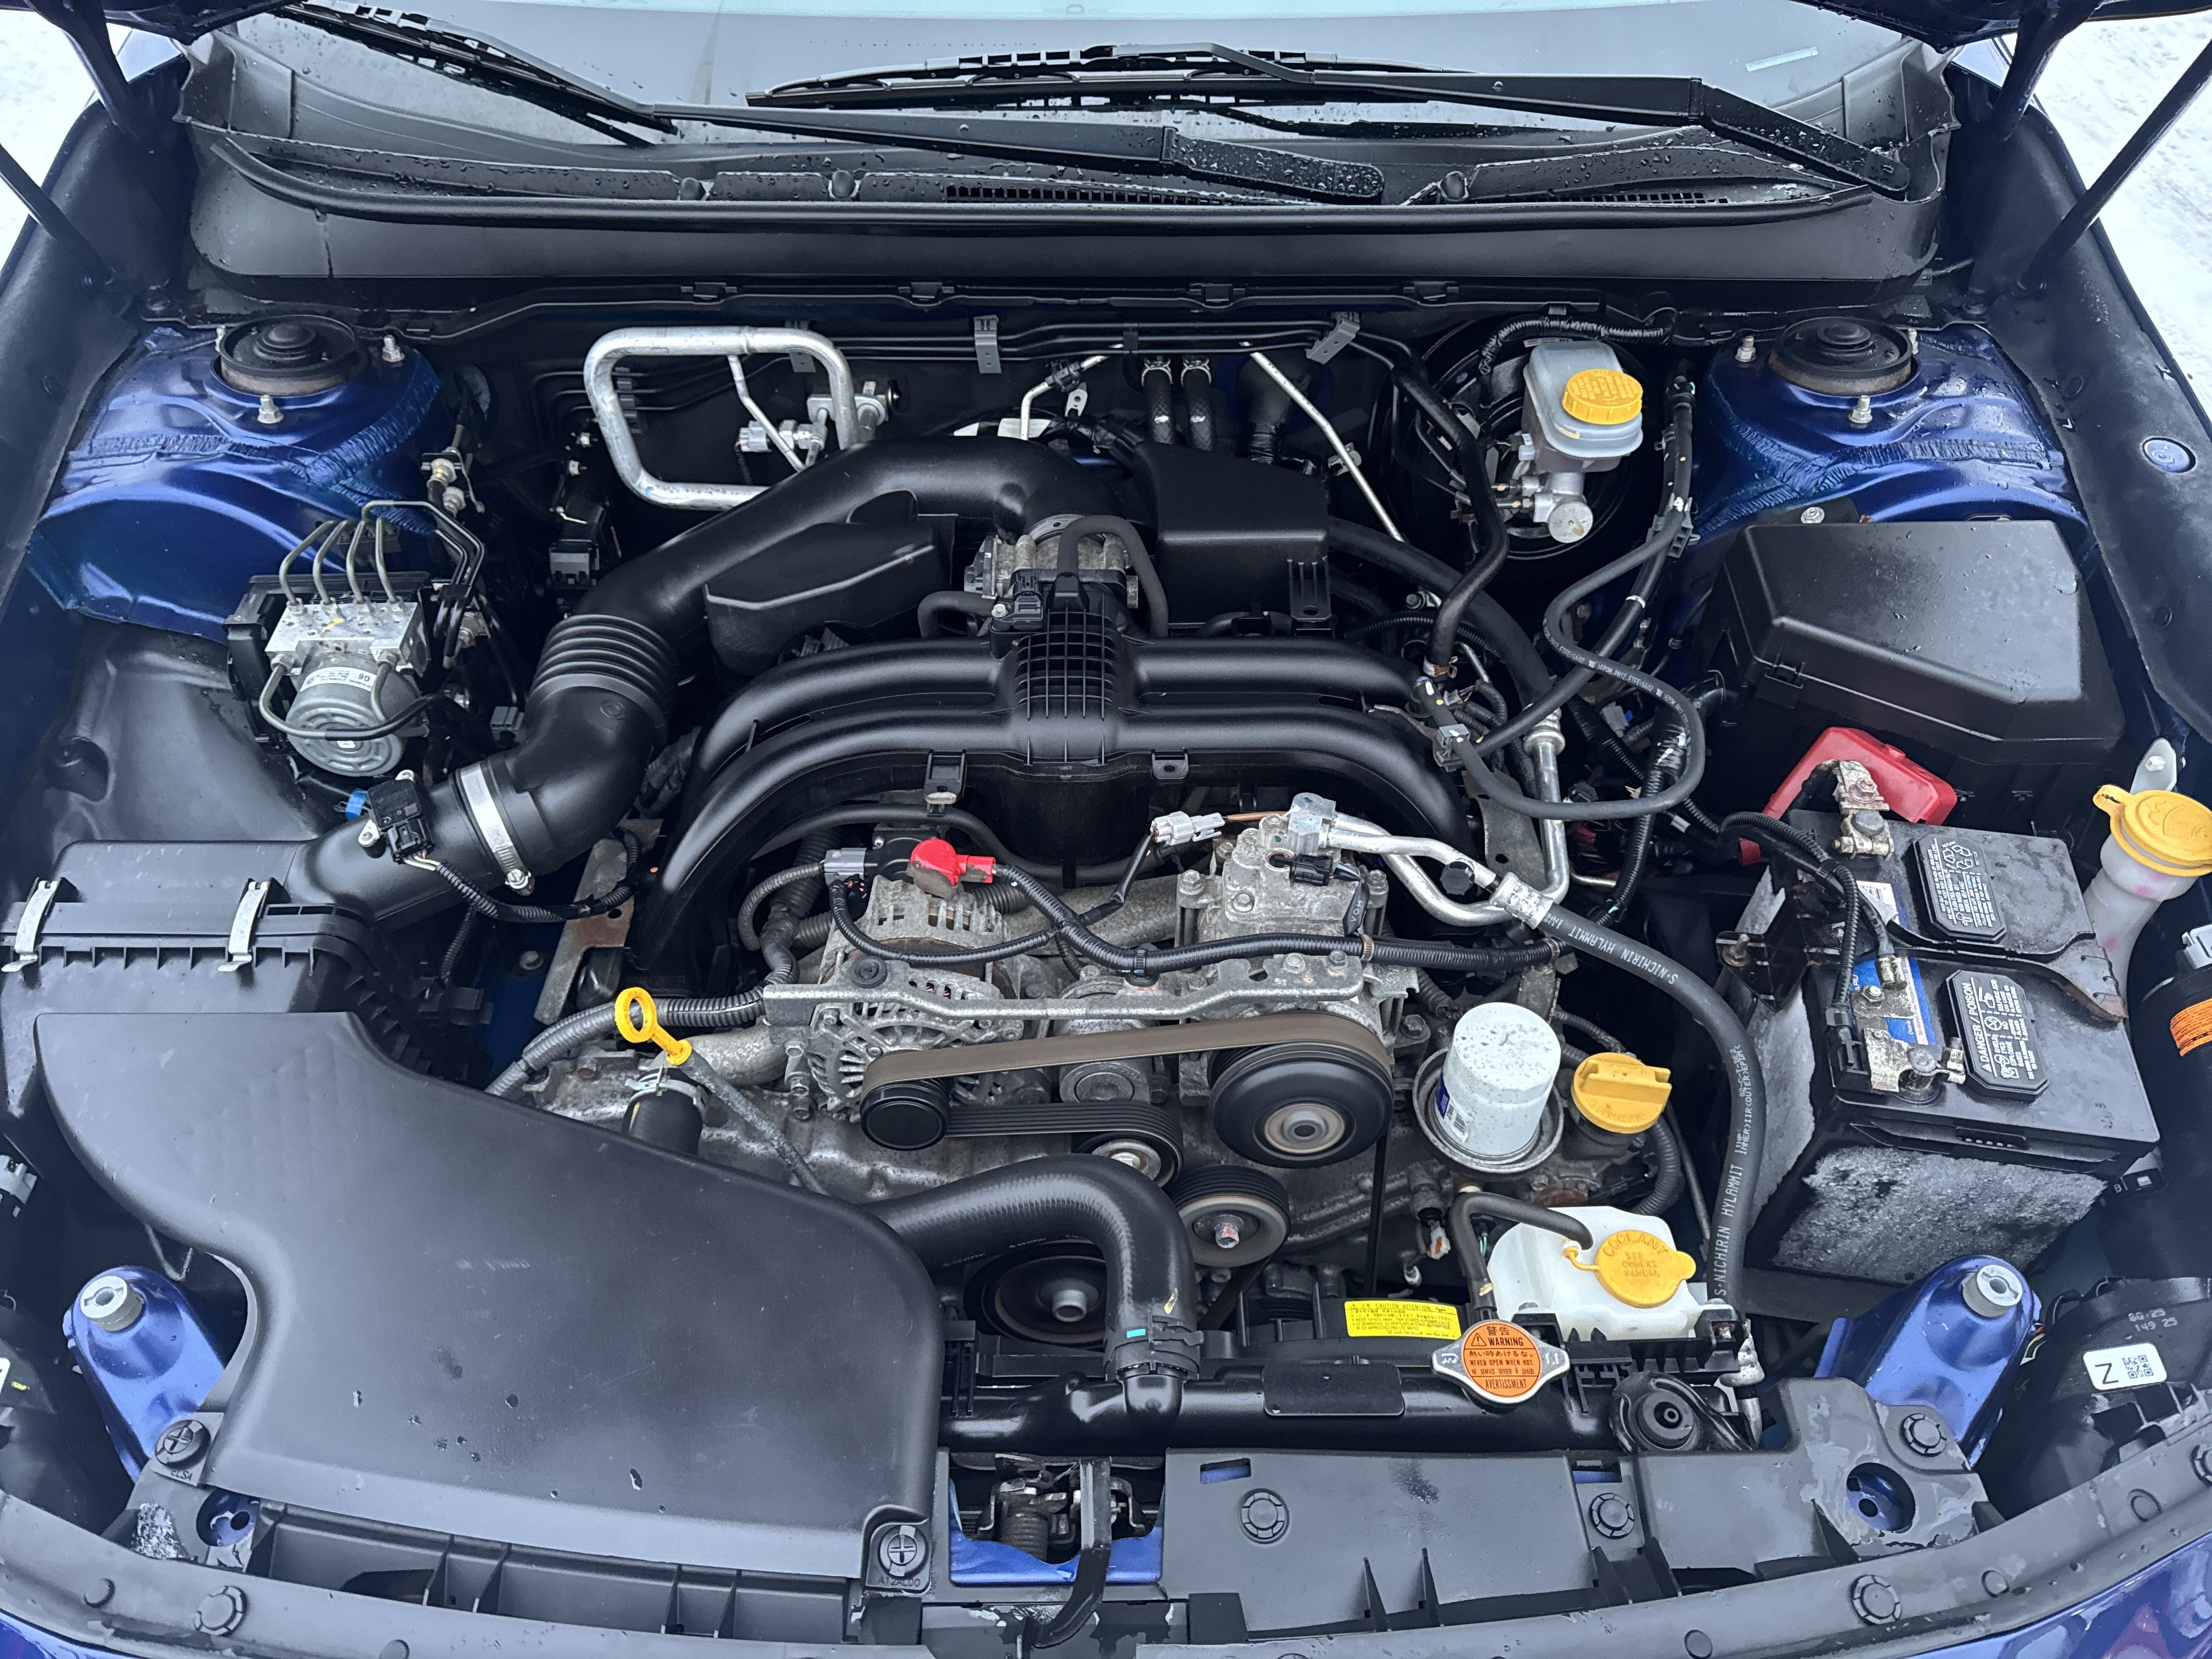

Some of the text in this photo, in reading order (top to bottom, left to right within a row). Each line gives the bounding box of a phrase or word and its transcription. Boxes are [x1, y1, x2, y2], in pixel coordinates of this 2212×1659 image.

[1567, 926, 1616, 954] HYLAMMIT
[1961, 983, 1978, 1015] POISON
[2001, 1022, 2009, 1030] NO
[1972, 1025, 1990, 1062] DANGER
[1721, 1164, 1744, 1217] HYLAMMIT
[1603, 1233, 1668, 1256] COOLANT
[1487, 1325, 1510, 1336] 警告
[2162, 1317, 2177, 1327] 25
[1488, 1337, 1523, 1346] WARNING
[1486, 1379, 1526, 1389] AVERTISSMENT
[2095, 1363, 2119, 1385] Z
